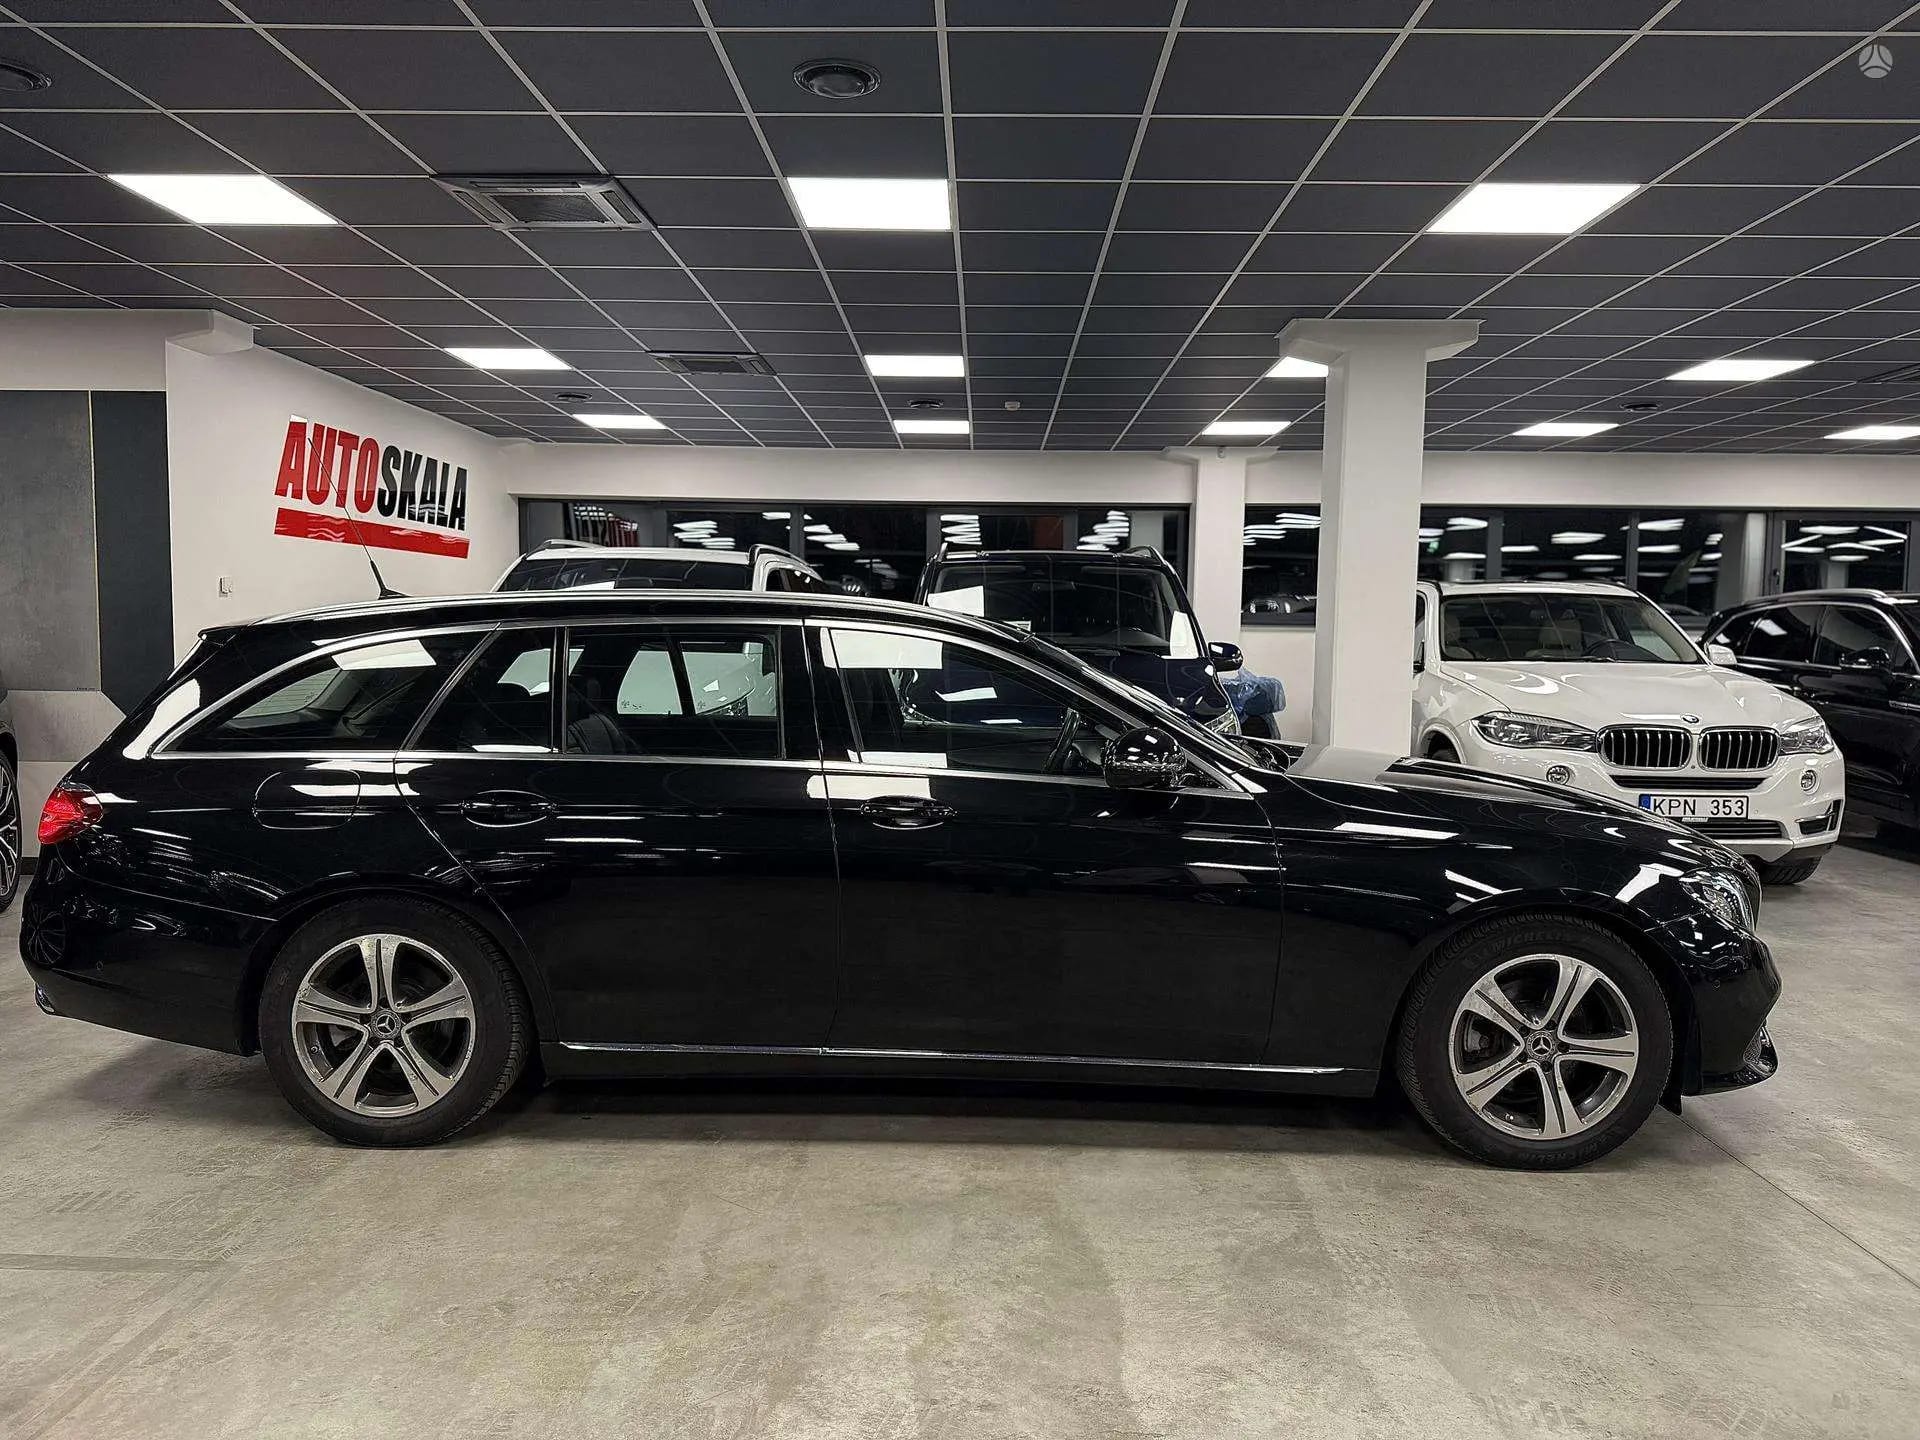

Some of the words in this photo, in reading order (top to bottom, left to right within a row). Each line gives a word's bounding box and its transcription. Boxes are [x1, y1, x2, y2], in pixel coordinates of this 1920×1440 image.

[274, 415, 468, 531] AUTOSKALA
[1653, 798, 1696, 816] KPN
[1710, 799, 1744, 816] 353
